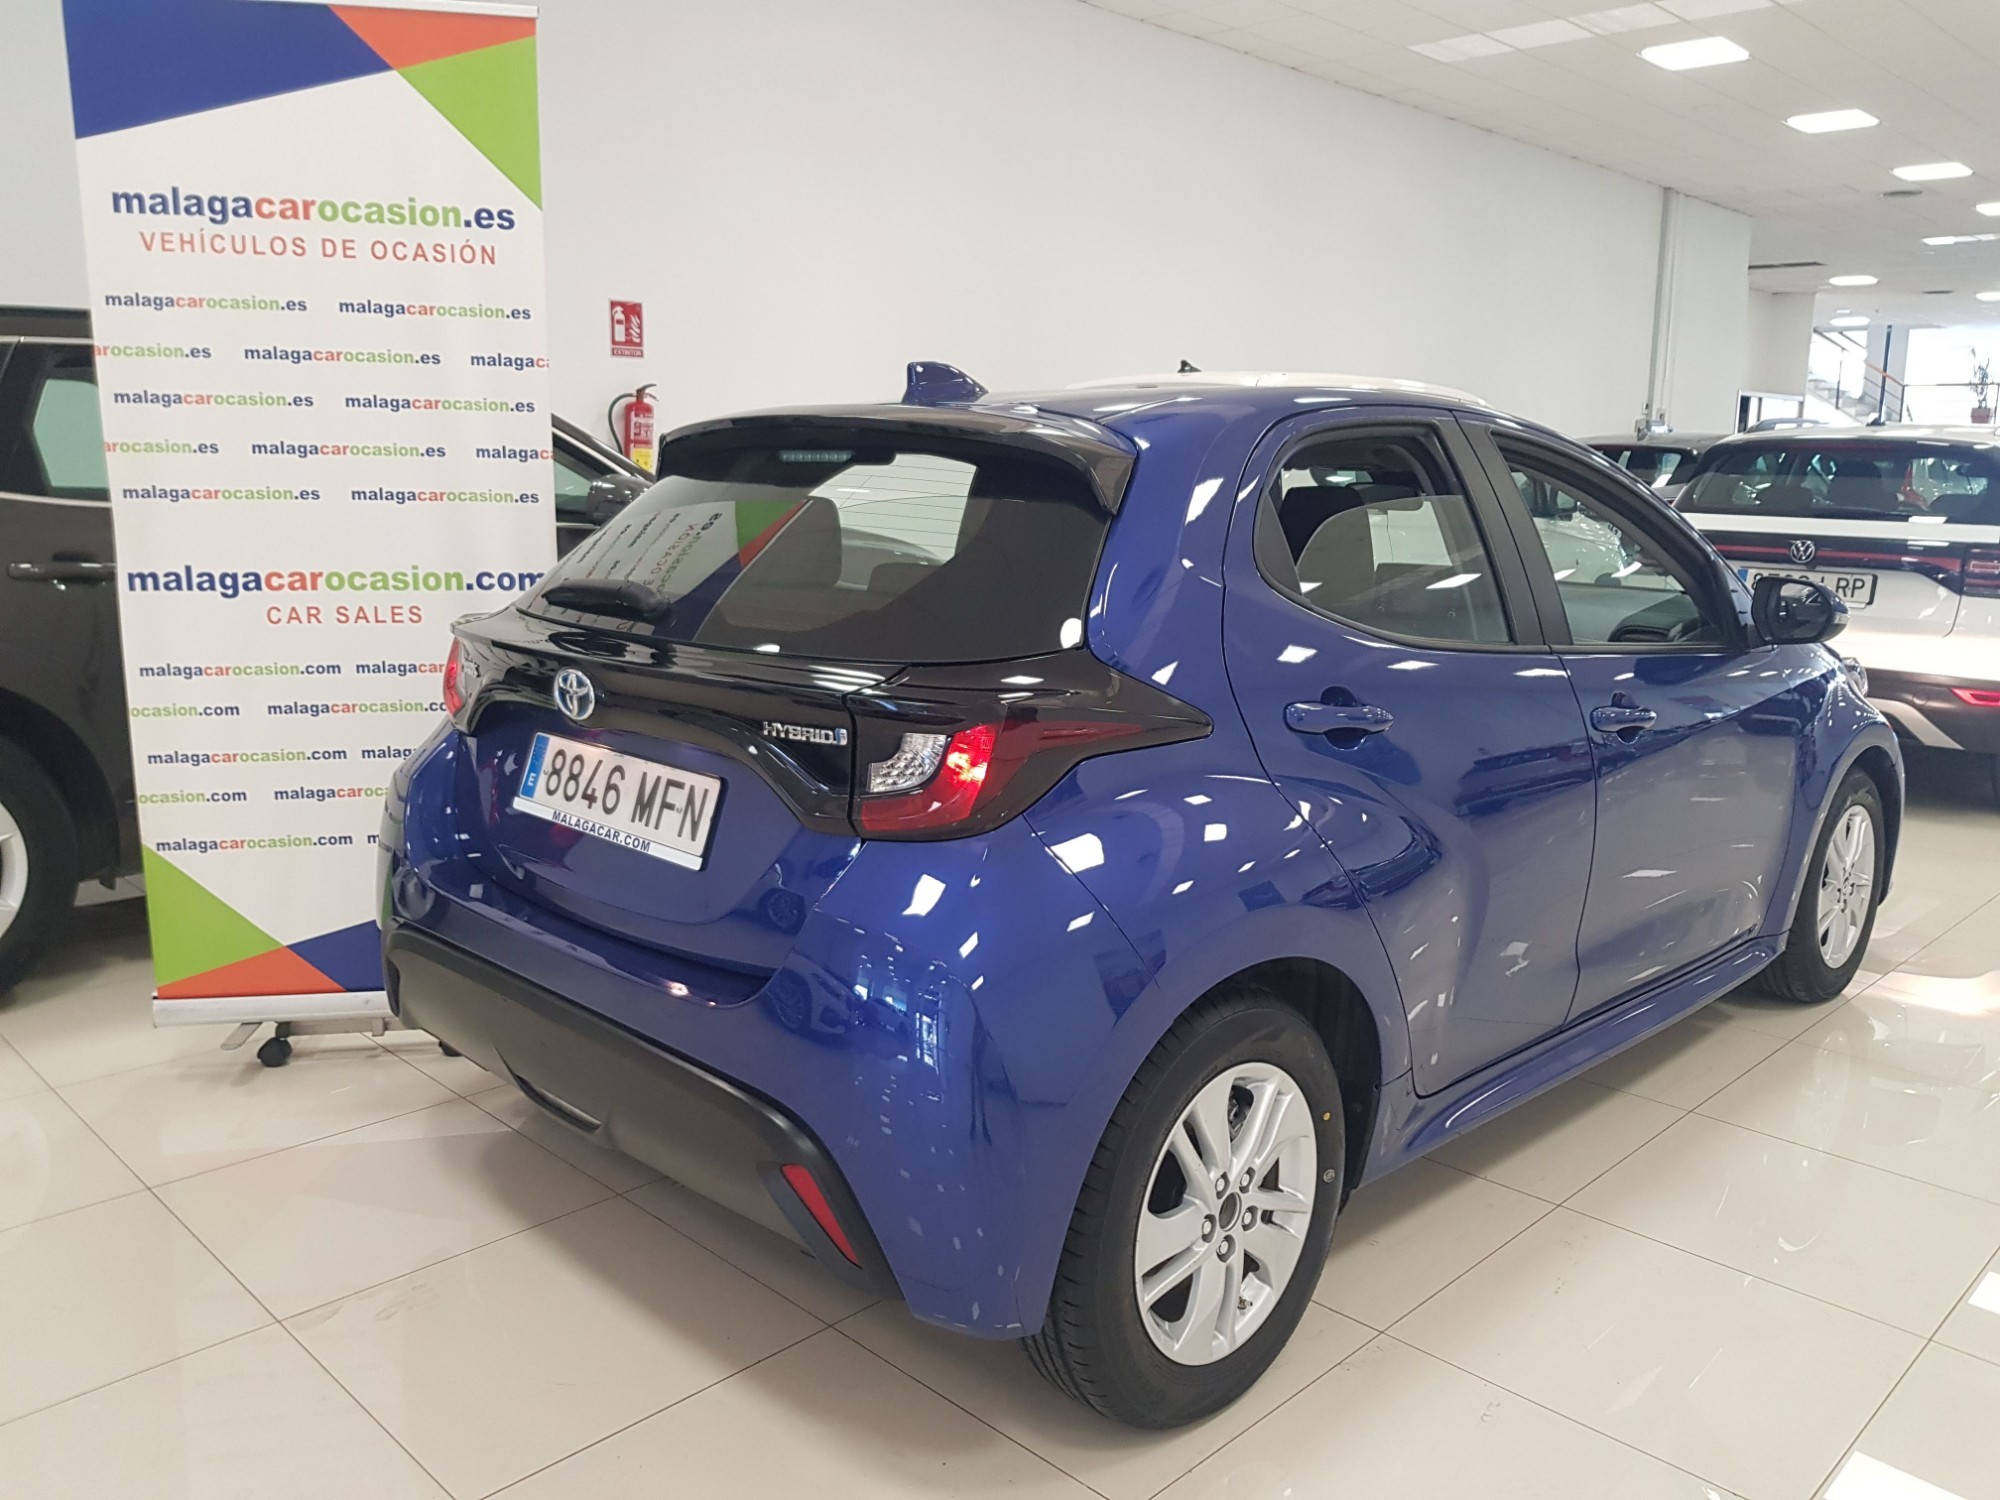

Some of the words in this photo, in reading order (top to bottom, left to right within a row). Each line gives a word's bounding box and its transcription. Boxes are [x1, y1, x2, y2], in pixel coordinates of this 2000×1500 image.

[112, 187, 515, 230] malagacarocasion.es
[140, 228, 306, 256] VEHÍCULOS
[322, 238, 356, 258] DE
[371, 238, 495, 264] OCASIÓN
[105, 293, 307, 311] malagacarocasion.es
[339, 300, 531, 319] malagacarocasion.es
[245, 346, 440, 364] malagacarocasion.es
[114, 390, 313, 407] malagacarocasion.es
[345, 395, 535, 412] malagacarocasion.es
[252, 441, 446, 458] malagacarocasion.es
[123, 485, 320, 502] malagacarocasion.es
[352, 488, 539, 504] malagacarocasion.es
[128, 565, 545, 598] malagacarocasion.com
[267, 606, 321, 625] CAR
[336, 606, 422, 624] SALES
[140, 663, 341, 679] malagacarocasion.com
[763, 721, 834, 744] HYBRID
[148, 749, 347, 766] malagacarocasion.com
[362, 746, 416, 760] malag
[274, 786, 388, 801] malagacaroc
[545, 749, 626, 815] 8846
[631, 772, 709, 842] MFN
[552, 811, 651, 852] MALAGACAR.COM
[156, 835, 353, 853] malagacarocasion.com
